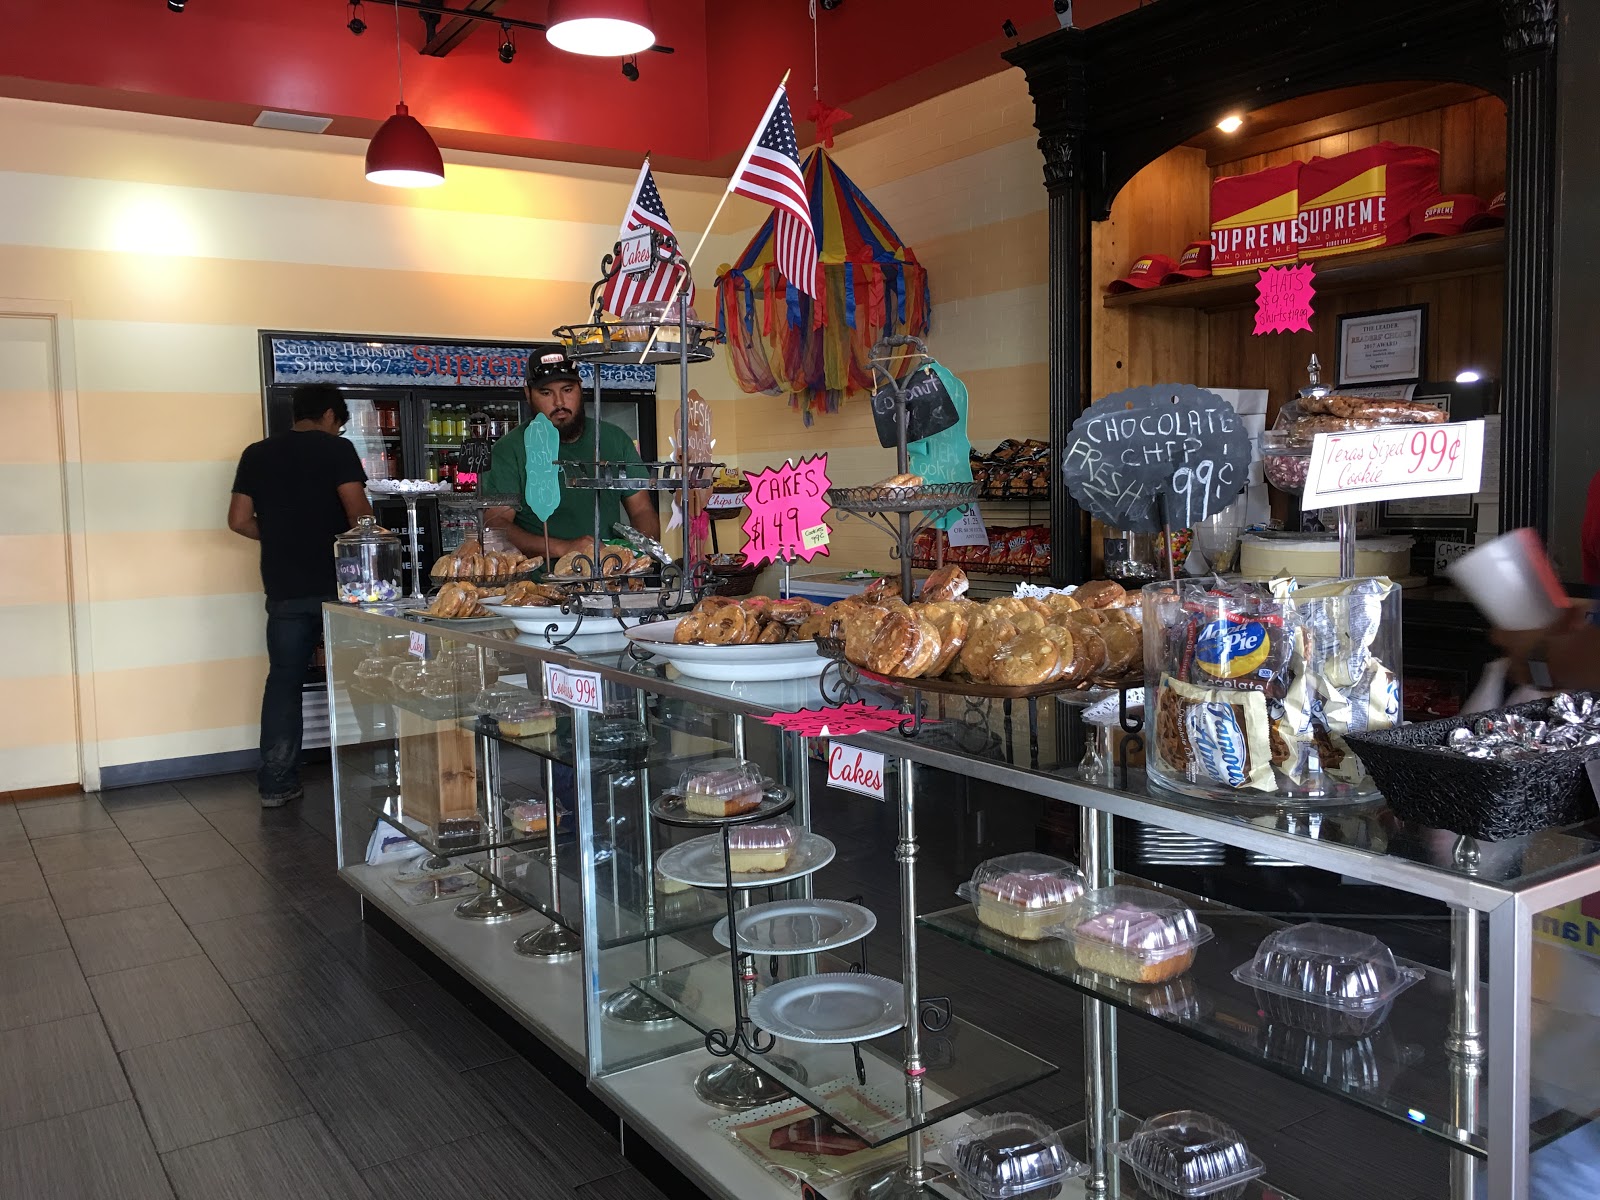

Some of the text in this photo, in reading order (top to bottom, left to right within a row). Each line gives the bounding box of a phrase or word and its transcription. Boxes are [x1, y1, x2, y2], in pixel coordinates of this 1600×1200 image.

[1298, 197, 1386, 244] SUPREME
[1424, 206, 1454, 219] SUPREME
[621, 240, 650, 268] Cakes
[1211, 219, 1298, 262] SUPREME
[1215, 245, 1291, 261] ANDWICHE
[1270, 273, 1304, 294] HATS
[1262, 292, 1296, 311] $9.99
[276, 341, 406, 360] Serving Houston
[294, 356, 392, 373] Since 1967
[412, 344, 529, 385] Suprem
[579, 369, 651, 382] everages
[874, 373, 939, 415] Coonut
[687, 398, 711, 436] RESH
[1087, 408, 1234, 443] CHOCOLATE
[1121, 437, 1203, 467] CHIP
[1327, 429, 1461, 474] Texas Sized 99¢
[756, 469, 820, 505] CAKES
[1063, 437, 1145, 517] FRESH
[1337, 463, 1383, 489] Cookie
[707, 494, 732, 509] Chips
[751, 507, 801, 551] $1.49
[401, 545, 425, 553] NTR
[401, 561, 423, 569] HEE
[1197, 622, 1247, 642] Moon
[1226, 631, 1259, 654] Pie
[576, 679, 596, 707] 99¢
[1203, 678, 1264, 692] ocolate
[1191, 714, 1223, 783] Amos
[1206, 702, 1245, 788] Famous
[829, 746, 882, 791] Cakes
